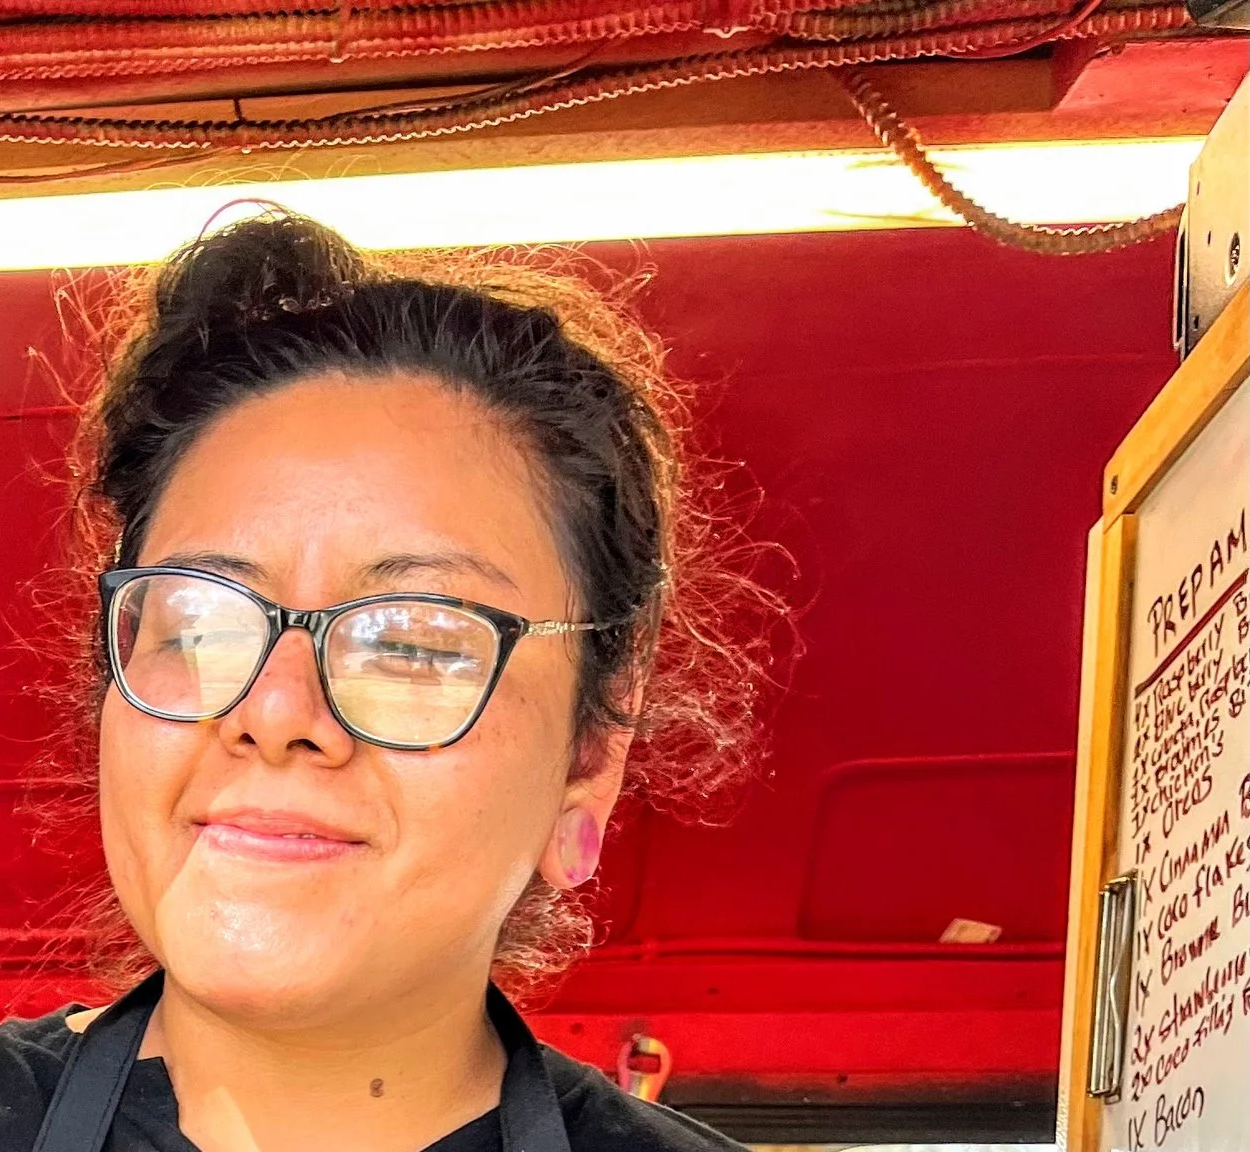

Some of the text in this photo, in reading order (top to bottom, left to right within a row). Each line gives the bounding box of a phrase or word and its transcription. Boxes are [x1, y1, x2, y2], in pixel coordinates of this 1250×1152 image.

[1147, 508, 1247, 657] PREP AM
[1154, 1086, 1204, 1147] Bacon
